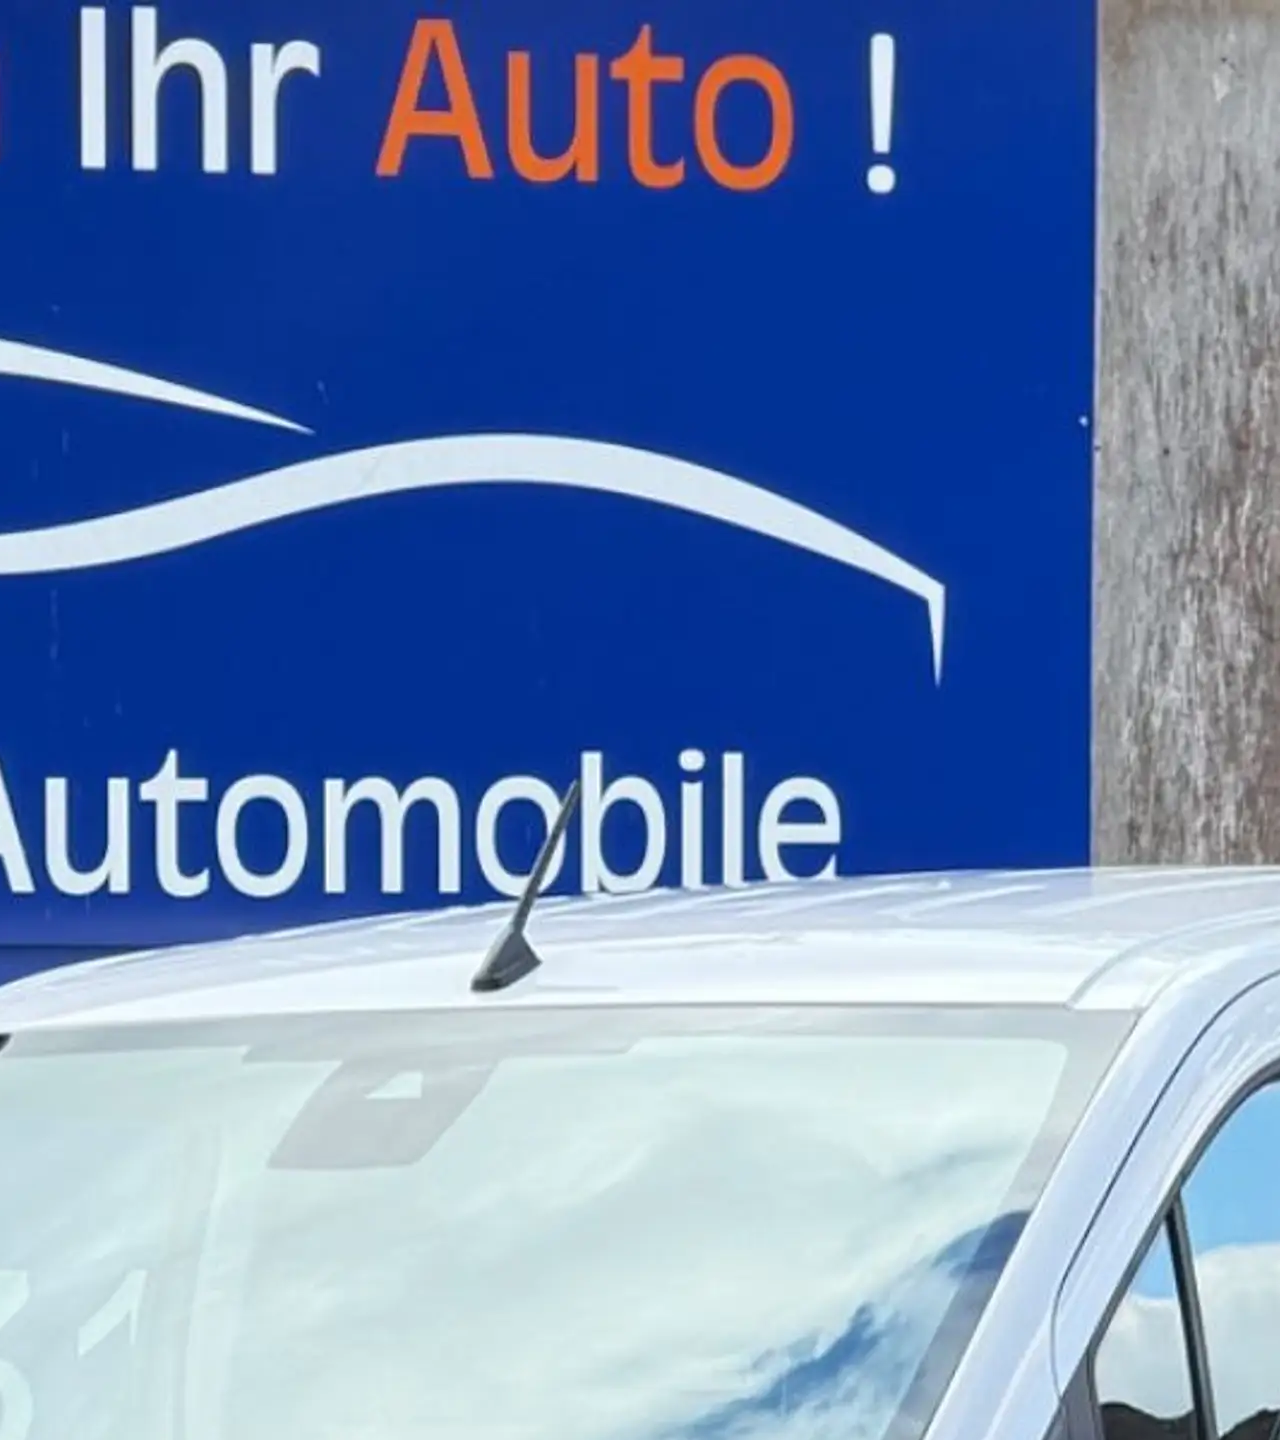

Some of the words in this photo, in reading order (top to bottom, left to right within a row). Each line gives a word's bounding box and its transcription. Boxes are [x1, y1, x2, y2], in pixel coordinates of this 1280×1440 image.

[81, 7, 320, 174] Ihr
[376, 19, 794, 190] Auto
[867, 33, 896, 192] !
